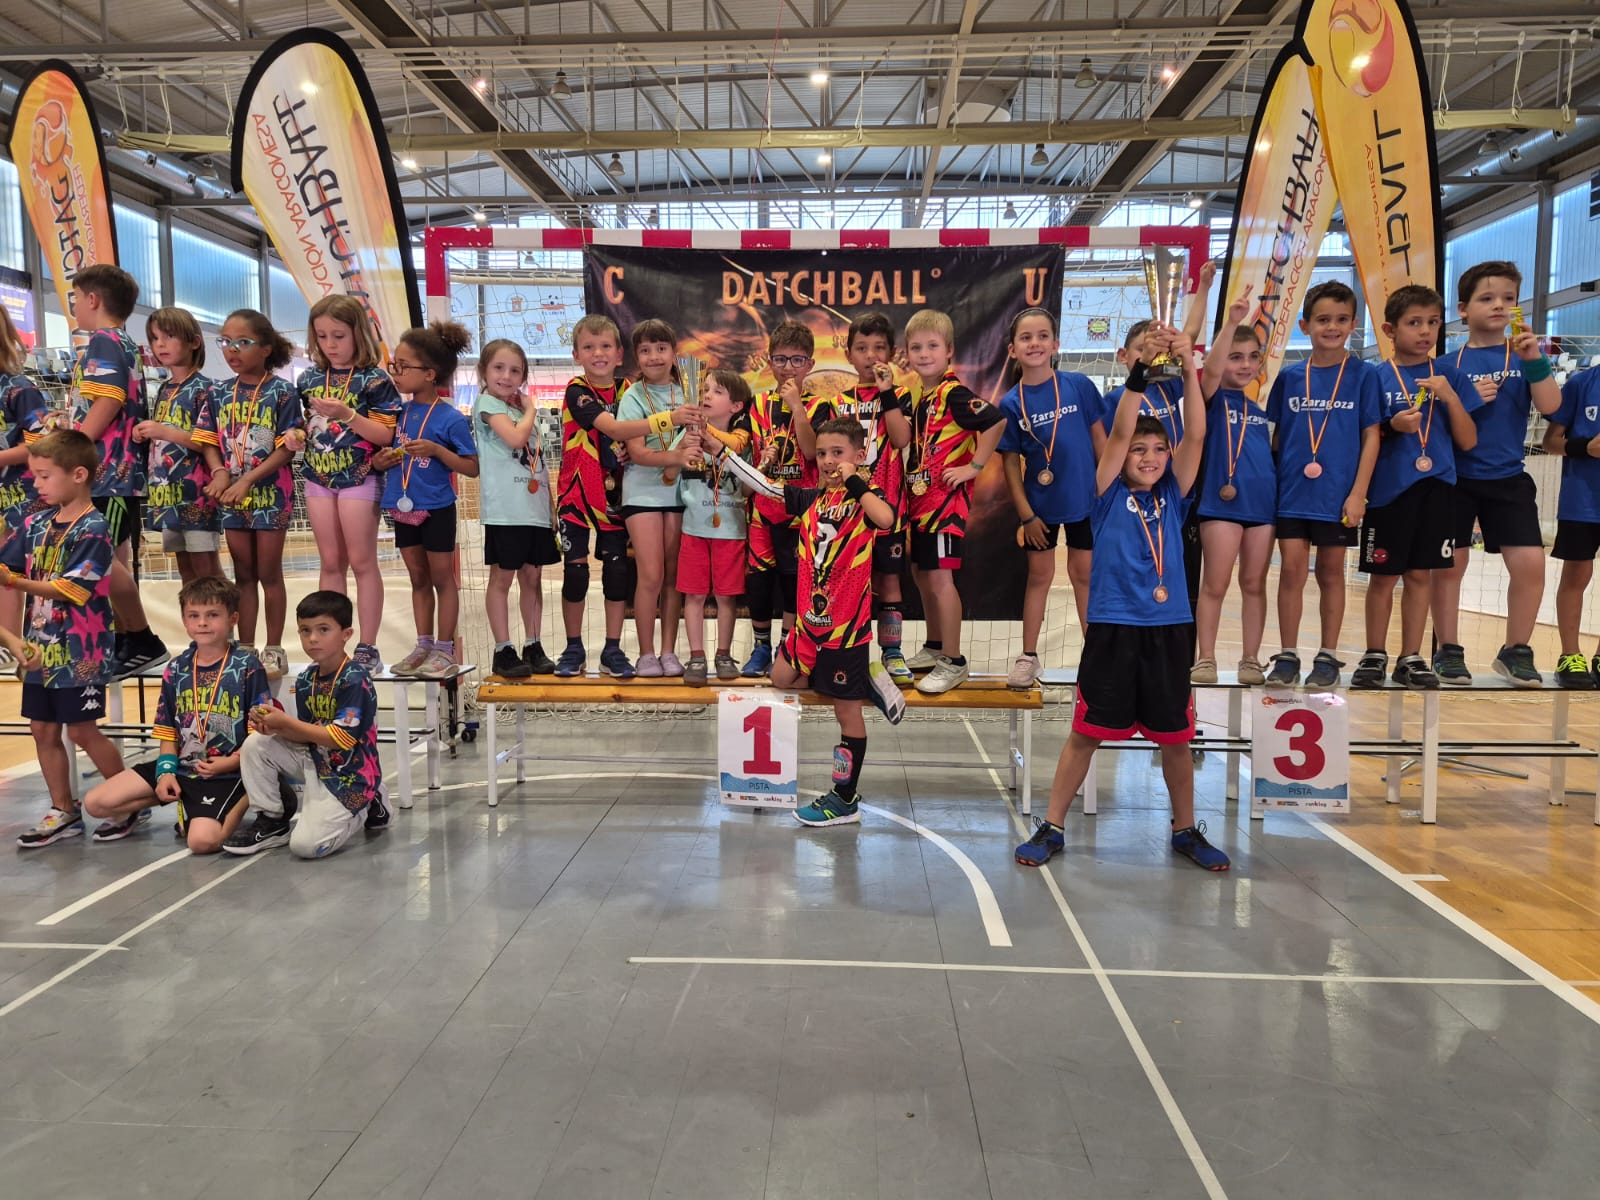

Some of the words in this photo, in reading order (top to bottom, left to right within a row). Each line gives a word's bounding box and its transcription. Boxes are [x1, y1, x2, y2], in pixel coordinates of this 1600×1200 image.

[604, 266, 625, 304] C
[1023, 268, 1048, 306] U
[1031, 404, 1078, 424] Zaragoza
[1301, 397, 1354, 410] Zaragoza
[743, 706, 782, 775] 1
[1273, 708, 1326, 780] 3
[748, 782, 770, 790] PISTA
[1288, 787, 1312, 795] PISTA
